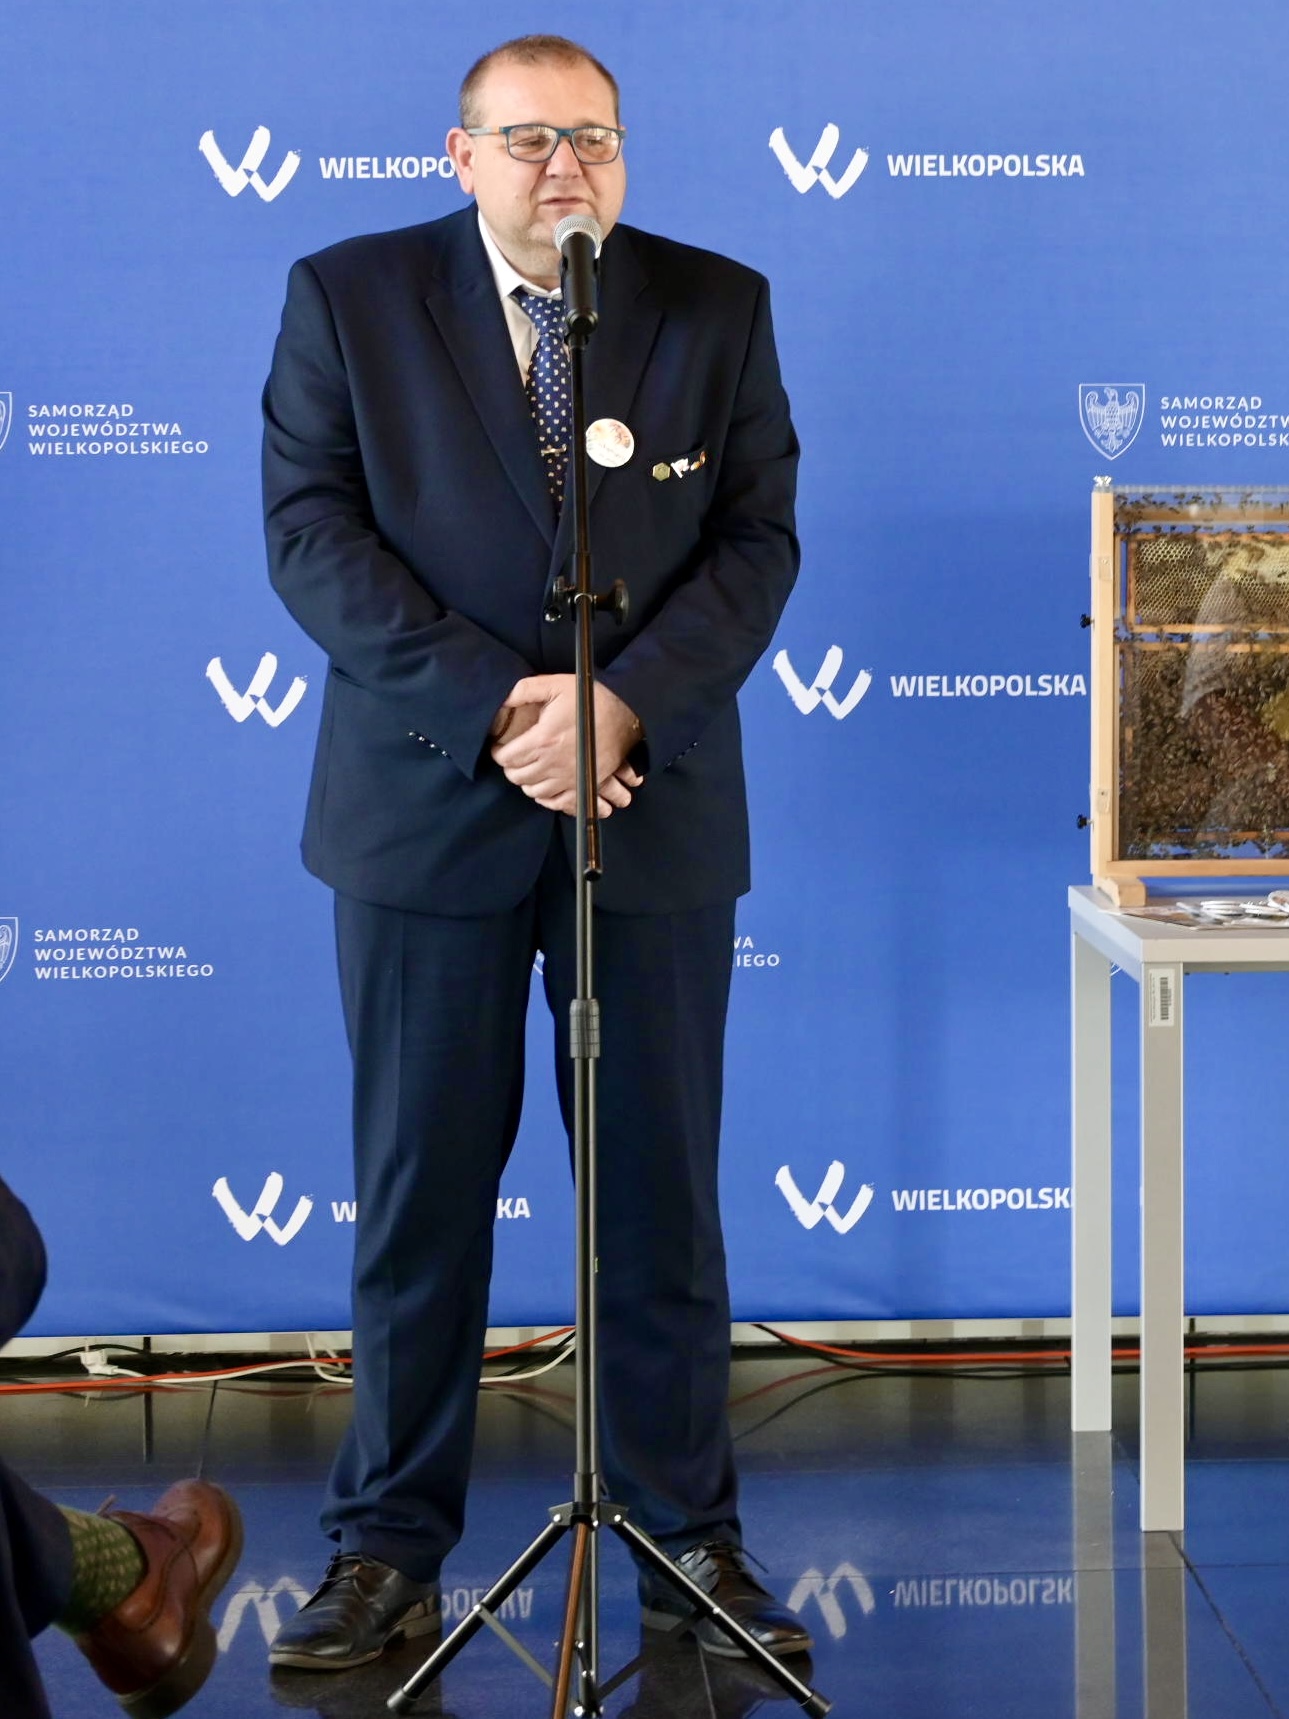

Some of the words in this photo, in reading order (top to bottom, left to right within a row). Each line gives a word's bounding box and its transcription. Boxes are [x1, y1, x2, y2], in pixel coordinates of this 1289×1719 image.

[319, 156, 456, 179] WIELKOPO
[887, 154, 1085, 178] WIELKOPOLSKA
[29, 404, 134, 420] SAMORZĄD
[1160, 396, 1262, 413] SAMORZĄD
[29, 420, 182, 437] WOJEWÓDZTWA
[29, 440, 209, 455] WIELKOPOLSKIEGO
[889, 674, 1087, 697] WIELKOPOLSKA
[35, 928, 139, 944] SAMORZĄD
[35, 944, 187, 961] WOJEWÓDZTWA
[35, 964, 214, 980] WIELKOPOLSKIEGO
[891, 1187, 1072, 1211] WIELKOPOLSK
